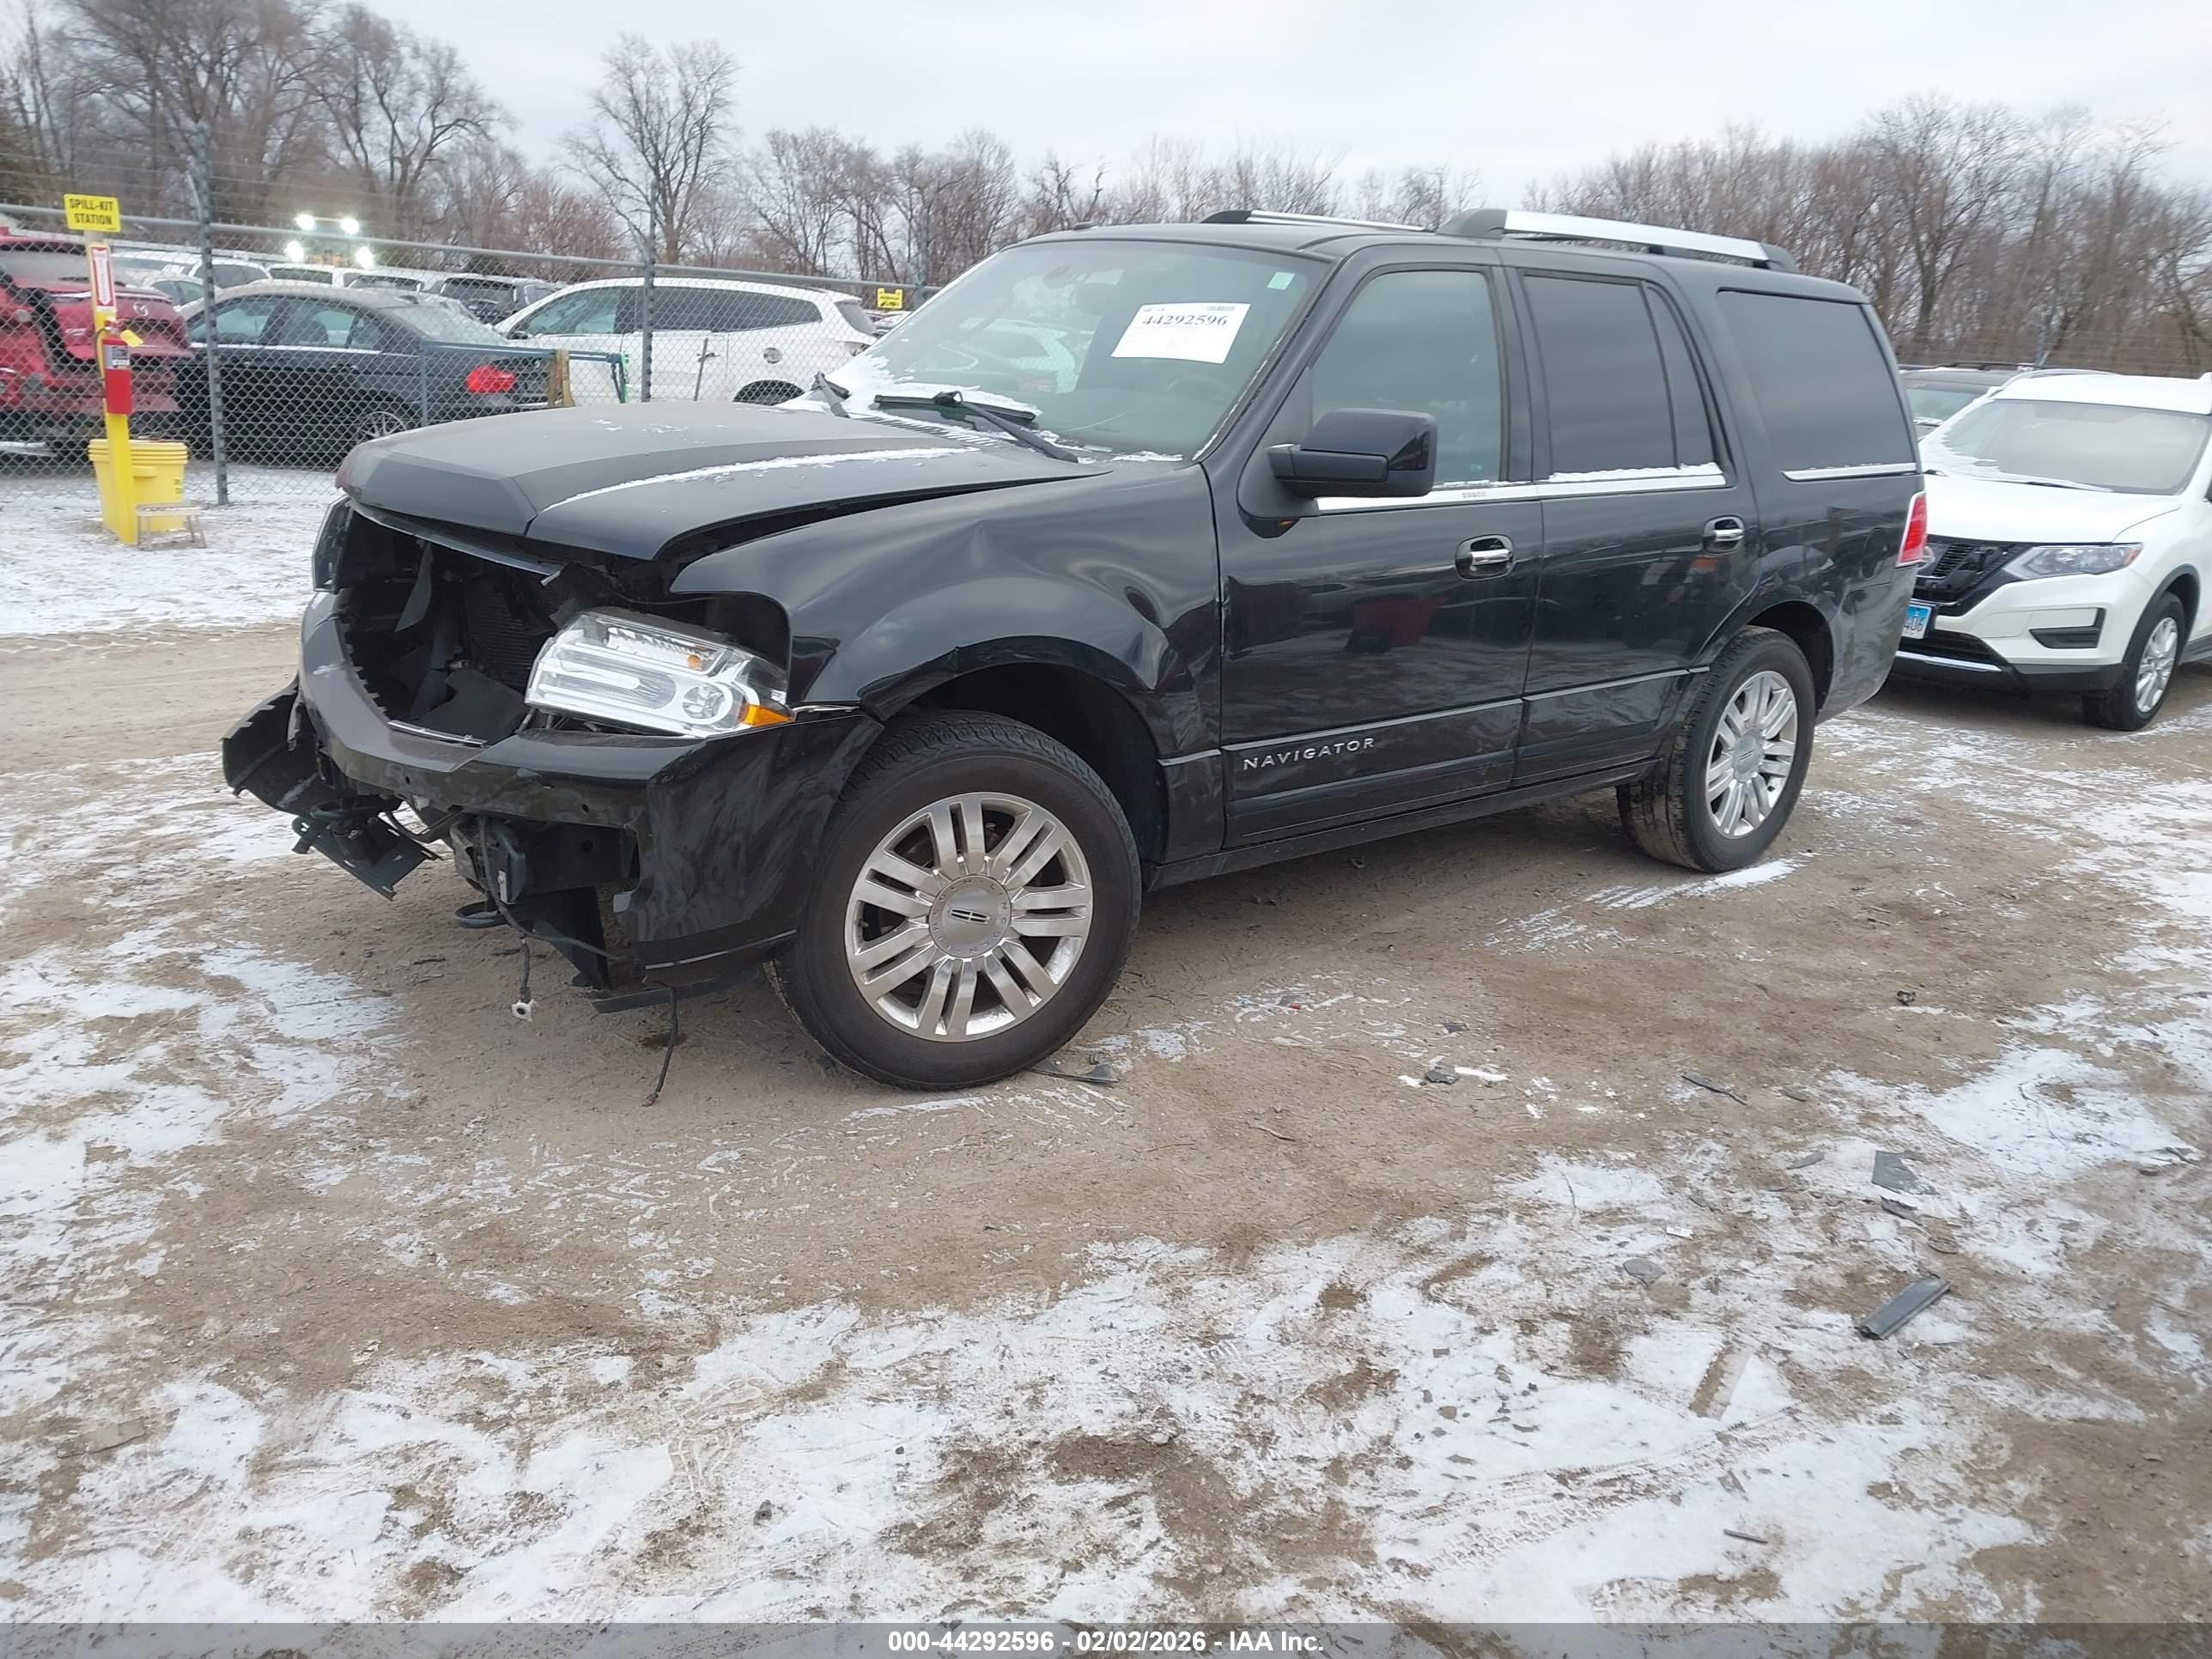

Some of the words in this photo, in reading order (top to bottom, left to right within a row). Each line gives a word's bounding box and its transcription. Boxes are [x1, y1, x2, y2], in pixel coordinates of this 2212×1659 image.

[69, 198, 112, 211] SPILL-KIT
[74, 213, 112, 225] STATION
[1142, 315, 1227, 325] 44292596
[1243, 738, 1375, 771] NAVIGATOR
